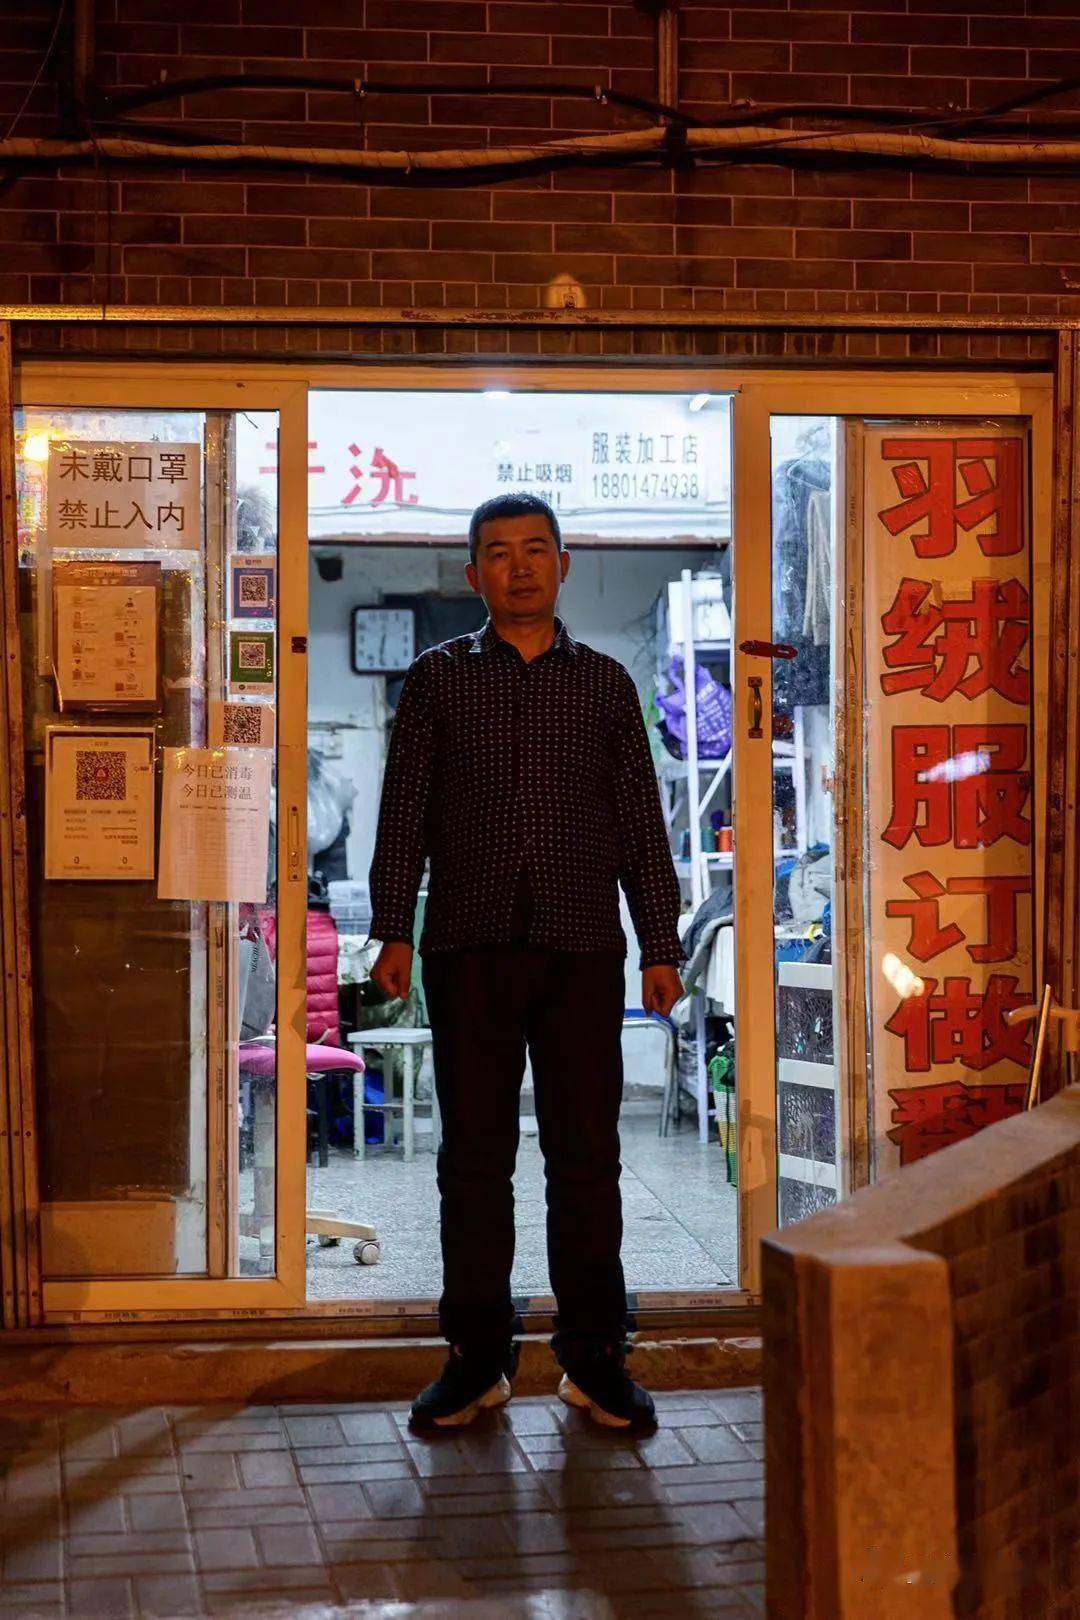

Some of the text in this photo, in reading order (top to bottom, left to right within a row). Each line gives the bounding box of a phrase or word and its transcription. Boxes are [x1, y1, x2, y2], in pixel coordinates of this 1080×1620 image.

[592, 432, 698, 464] 服装加工店
[59, 451, 188, 484] 未戴口罩
[497, 463, 572, 483] 禁止吸烟
[593, 473, 699, 499] 18801474938
[58, 499, 185, 532] 禁止入内
